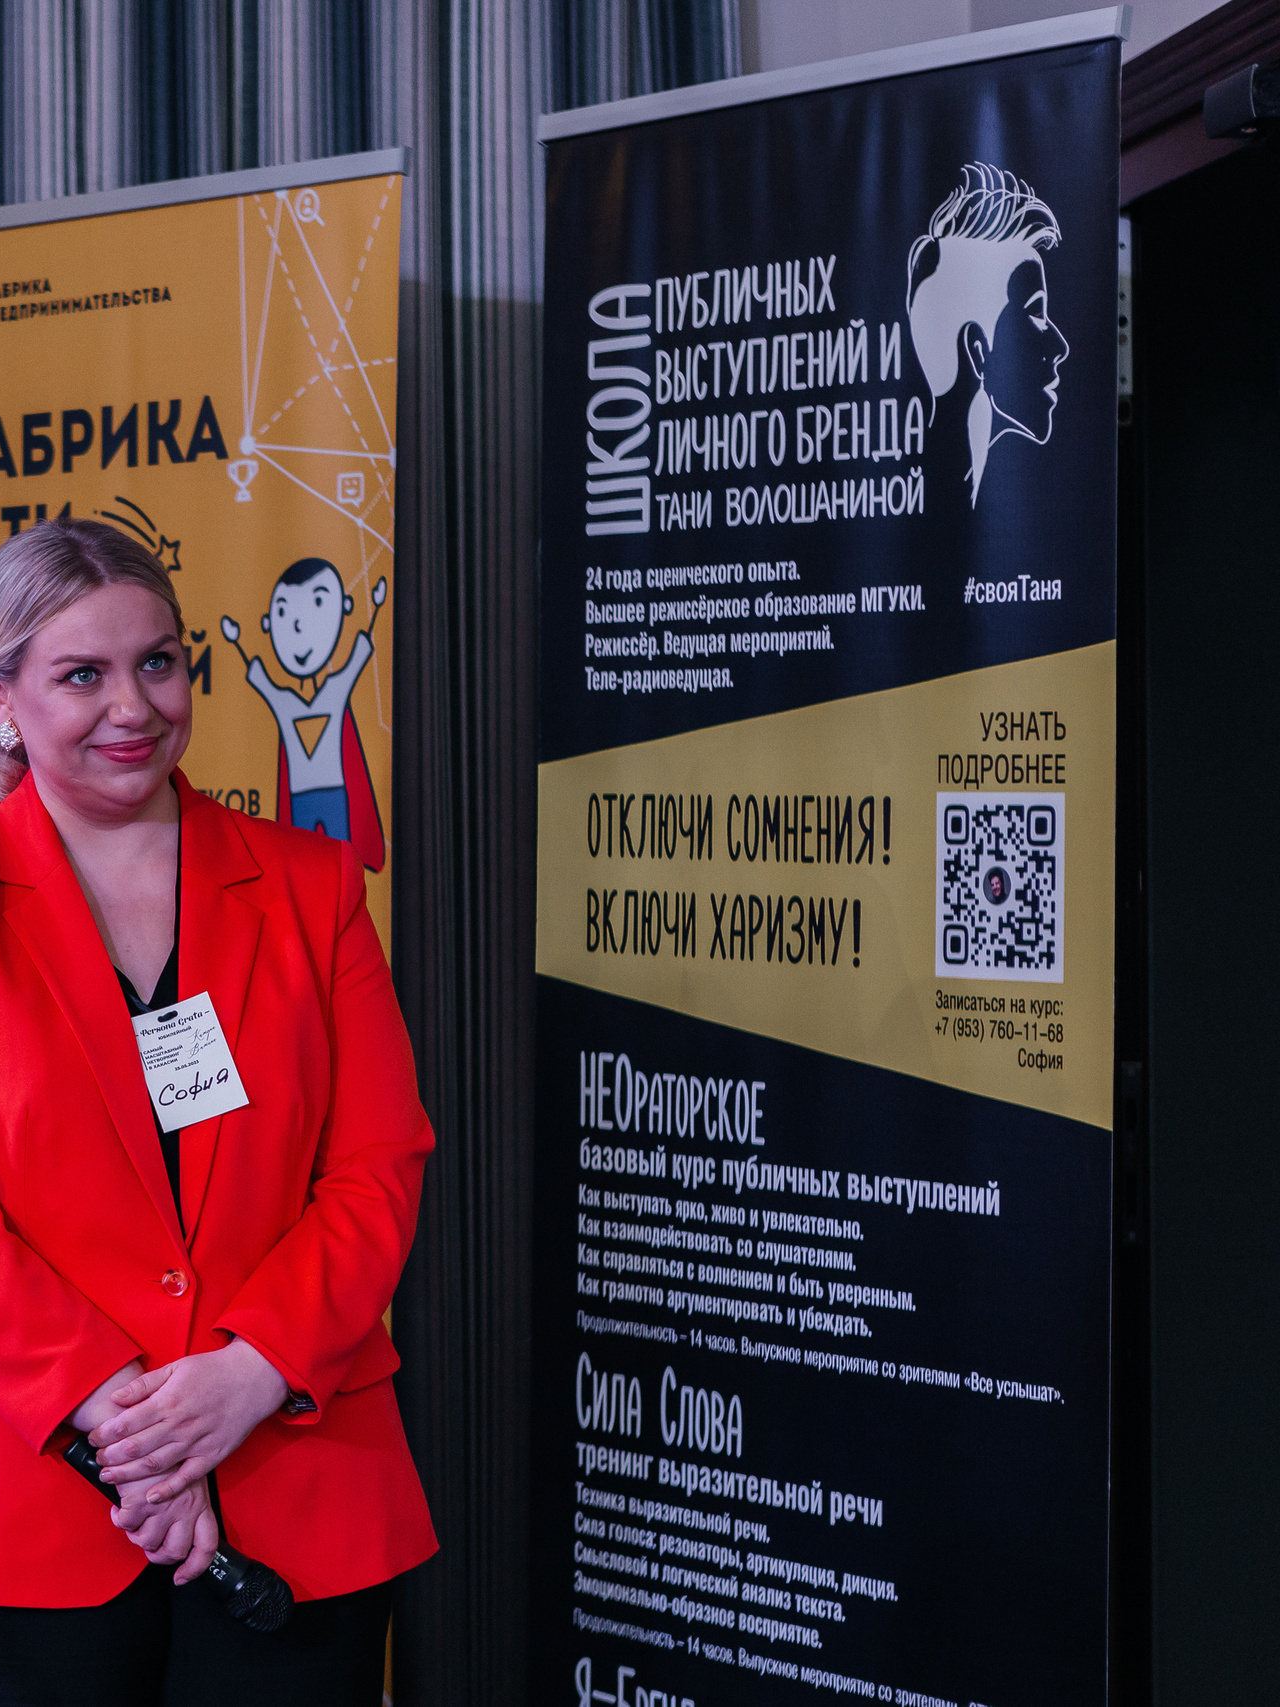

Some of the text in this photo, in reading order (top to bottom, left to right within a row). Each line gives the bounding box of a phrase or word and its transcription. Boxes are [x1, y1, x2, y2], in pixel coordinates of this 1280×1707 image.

[656, 254, 837, 334] ПУБЛИЧНЫХ
[655, 318, 902, 405] ВЫСТУПЛЕНИЙ И
[585, 282, 652, 537] ШКОЛА
[654, 395, 925, 476] ЛИЧНОГО БРЕНДА
[655, 466, 925, 532] ТАНИ ВОЛОШАНИНОЙ
[585, 560, 801, 593] 24 года сценического опыта.
[585, 584, 926, 627] Высшее режиссёрское образование МГУКИ.
[963, 574, 1062, 604] #свояТаня
[585, 624, 835, 661] Режиссёр. Ведущая мероприятий.
[584, 665, 734, 695] Теле-радиоведущая.
[979, 710, 1067, 743] УЗНАТЬ
[937, 753, 1067, 790] ПОДРОБНЕЕ
[586, 792, 892, 866] ОТКЛЮЧИ СОМНЕНИЯ!
[585, 888, 862, 969] ВКЛЮЧИ ХАРИЗМУ!
[934, 1017, 949, 1037] +7
[952, 1017, 985, 1043] (953)
[935, 989, 1065, 1022] Записаться на курс:
[158, 1067, 229, 1106] София
[1017, 1047, 1063, 1073] София
[579, 1137, 1000, 1216] базовый курс публичных выступлений
[578, 1183, 864, 1241] Как выступать ярко, живо и увлекательно.
[578, 1213, 856, 1272] Как взаимодействовать со слушателями.
[577, 1242, 916, 1312] Как справляться с волнением и быть уверенным.
[577, 1272, 872, 1338] Как грамотно аргументировать и убеждать.
[577, 1309, 678, 1345] Продолжительность
[690, 1328, 703, 1349] 14
[705, 1332, 738, 1355] часов.
[741, 1336, 801, 1364] Выпускное
[803, 1349, 879, 1376] мероприятие
[882, 1361, 896, 1379] со
[899, 1363, 960, 1389] зрителями
[964, 1371, 993, 1395] «Все
[996, 1379, 1065, 1405] услышат».
[575, 1441, 883, 1528] тренинг выразительной речи
[575, 1481, 625, 1512] Техника
[629, 1496, 731, 1536] выразительной
[574, 1511, 606, 1539] Сила
[659, 1533, 744, 1573] резонаторы,
[746, 1551, 839, 1592] артикуляция,
[841, 1572, 898, 1602] дикция.
[574, 1540, 846, 1623] Смысловой и логический анализ текста.
[573, 1569, 823, 1650] Эмоционально-образное восприятие.
[573, 1607, 675, 1650] Продолжительность
[687, 1635, 700, 1656] 14
[702, 1642, 736, 1666] часов.
[738, 1647, 798, 1681] Выпускное
[800, 1665, 875, 1698] мероприятие
[878, 1684, 892, 1702] со
